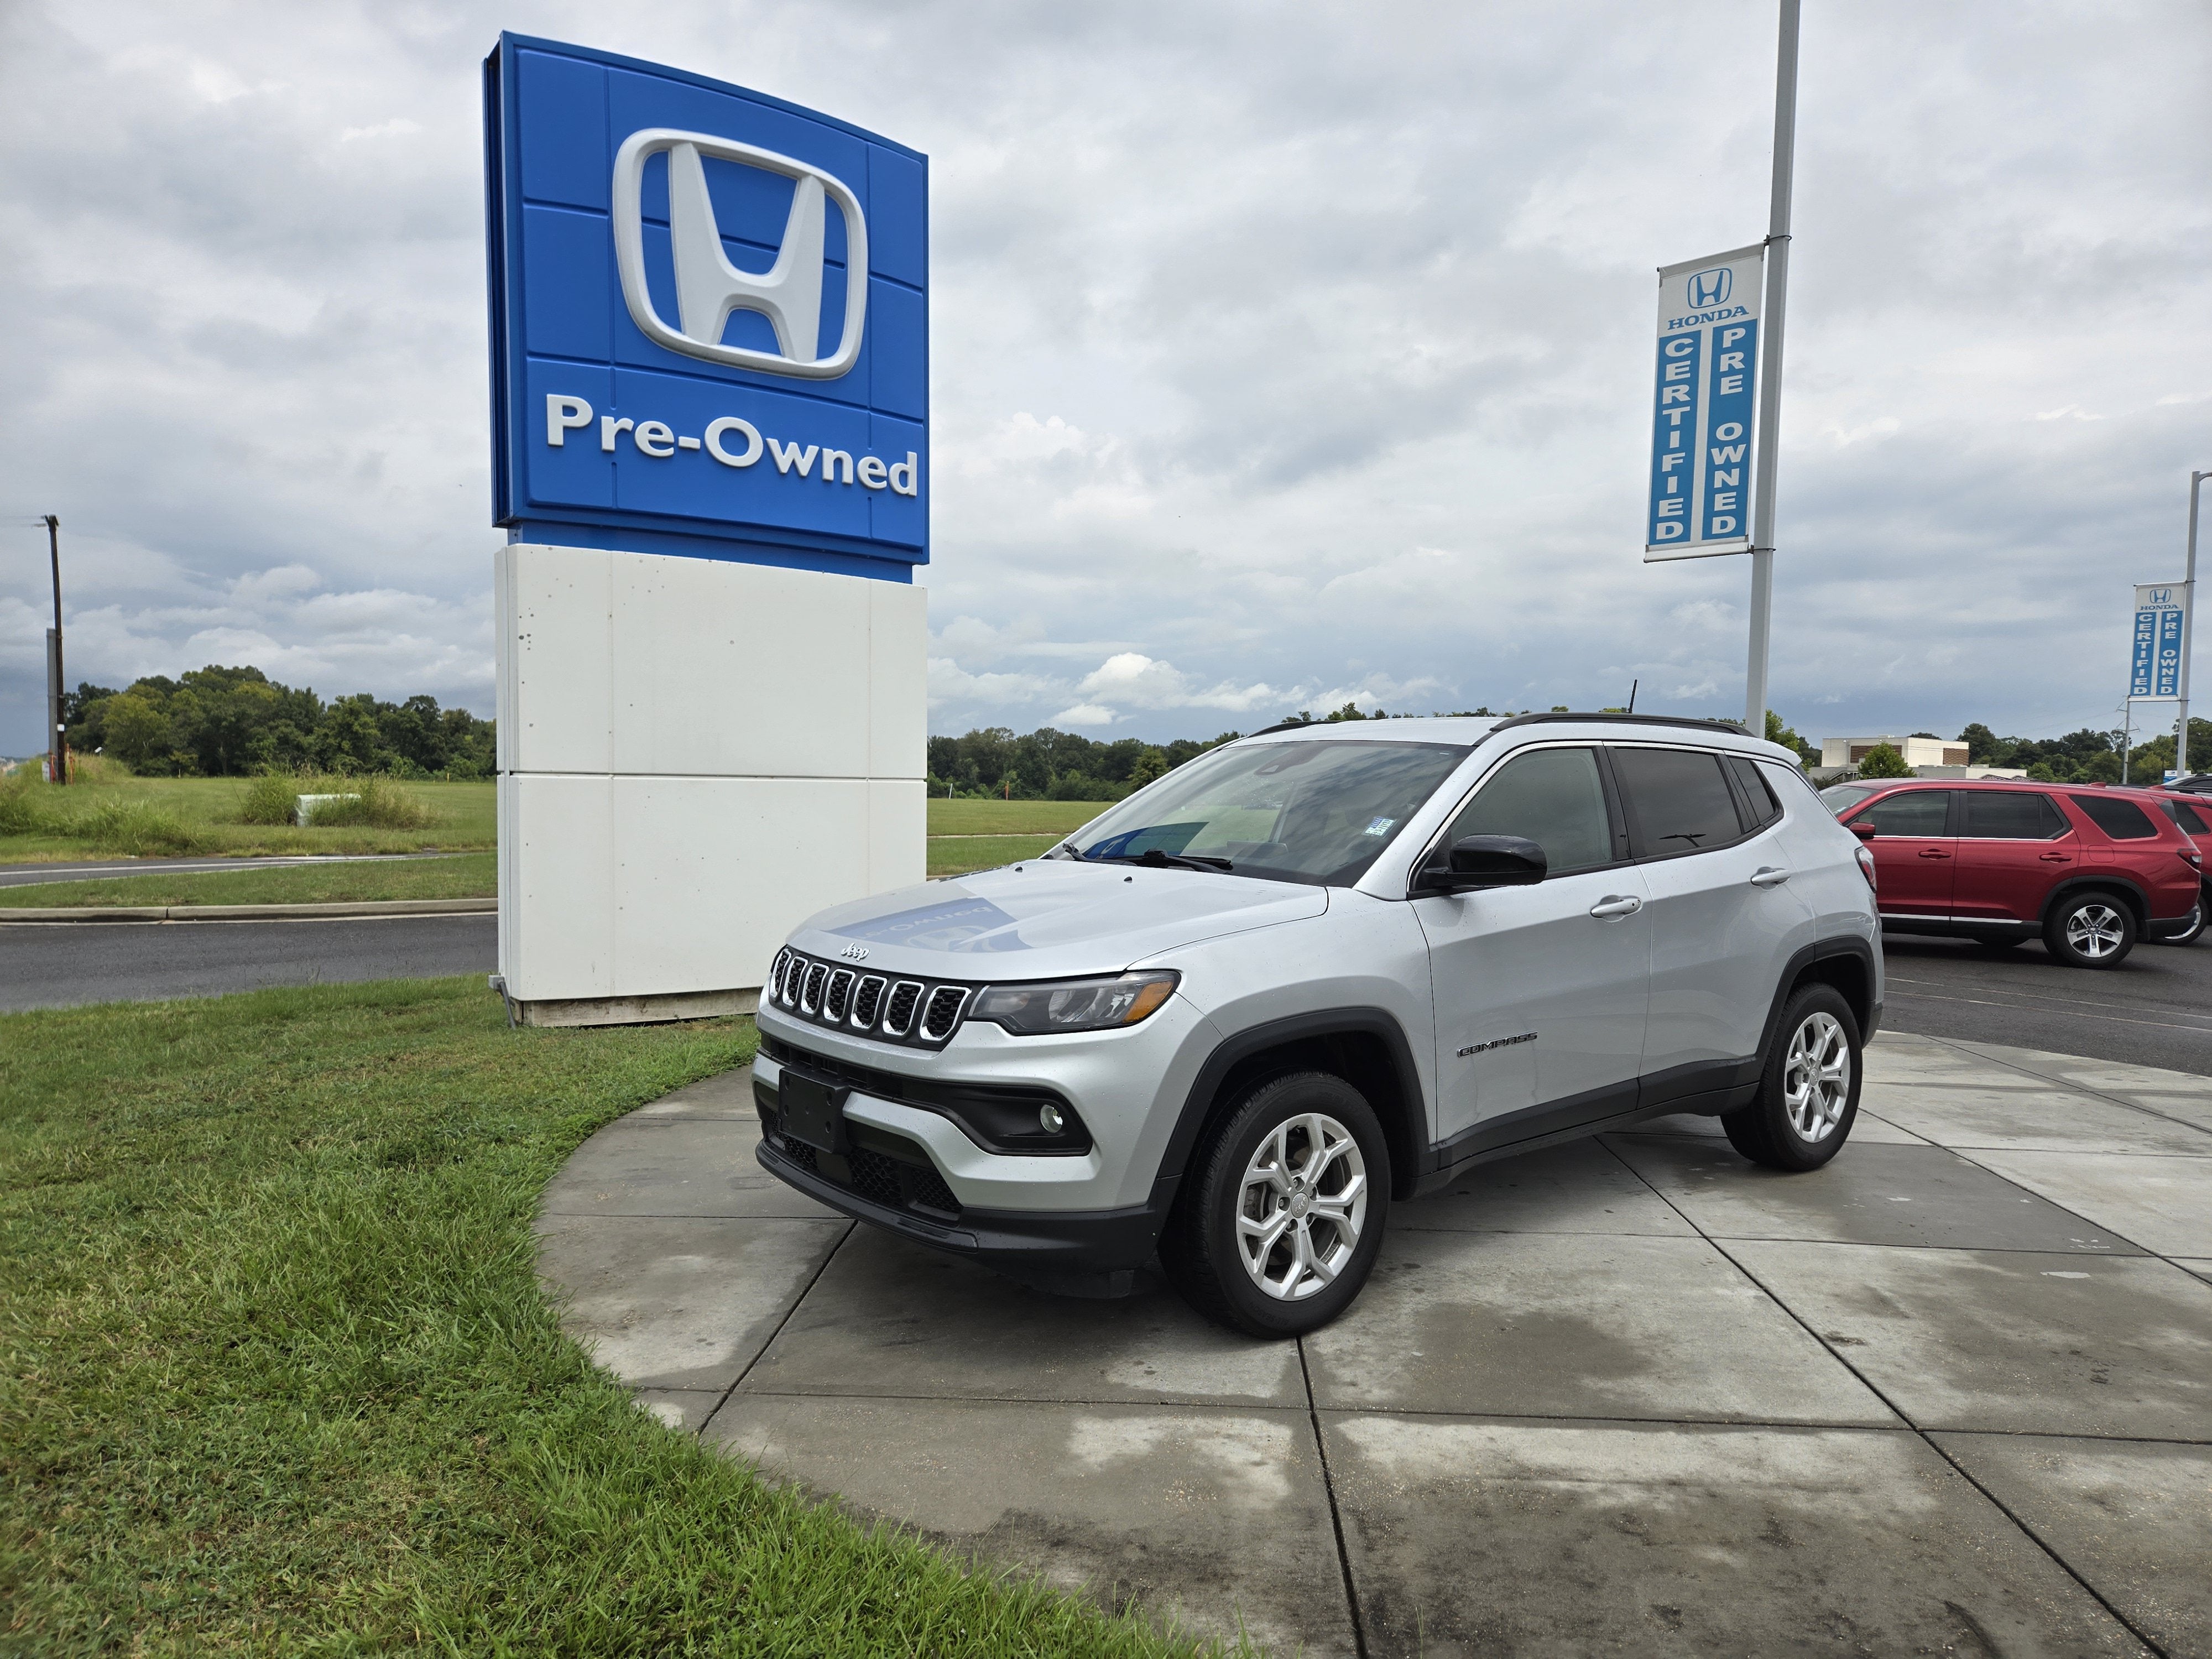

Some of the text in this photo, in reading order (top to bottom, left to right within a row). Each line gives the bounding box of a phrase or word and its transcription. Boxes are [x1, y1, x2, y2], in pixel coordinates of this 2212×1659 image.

[1668, 305, 1749, 330] HONDA
[546, 393, 918, 497] Pre-Owned
[1656, 337, 1694, 540] CERTIFIED
[1710, 327, 1747, 535] PRE OWNED
[2133, 614, 2153, 695] CERTIFIED
[2160, 613, 2177, 695] PRE OWNED
[841, 942, 870, 962] Jeep
[1456, 1031, 1538, 1058] COMPASS
